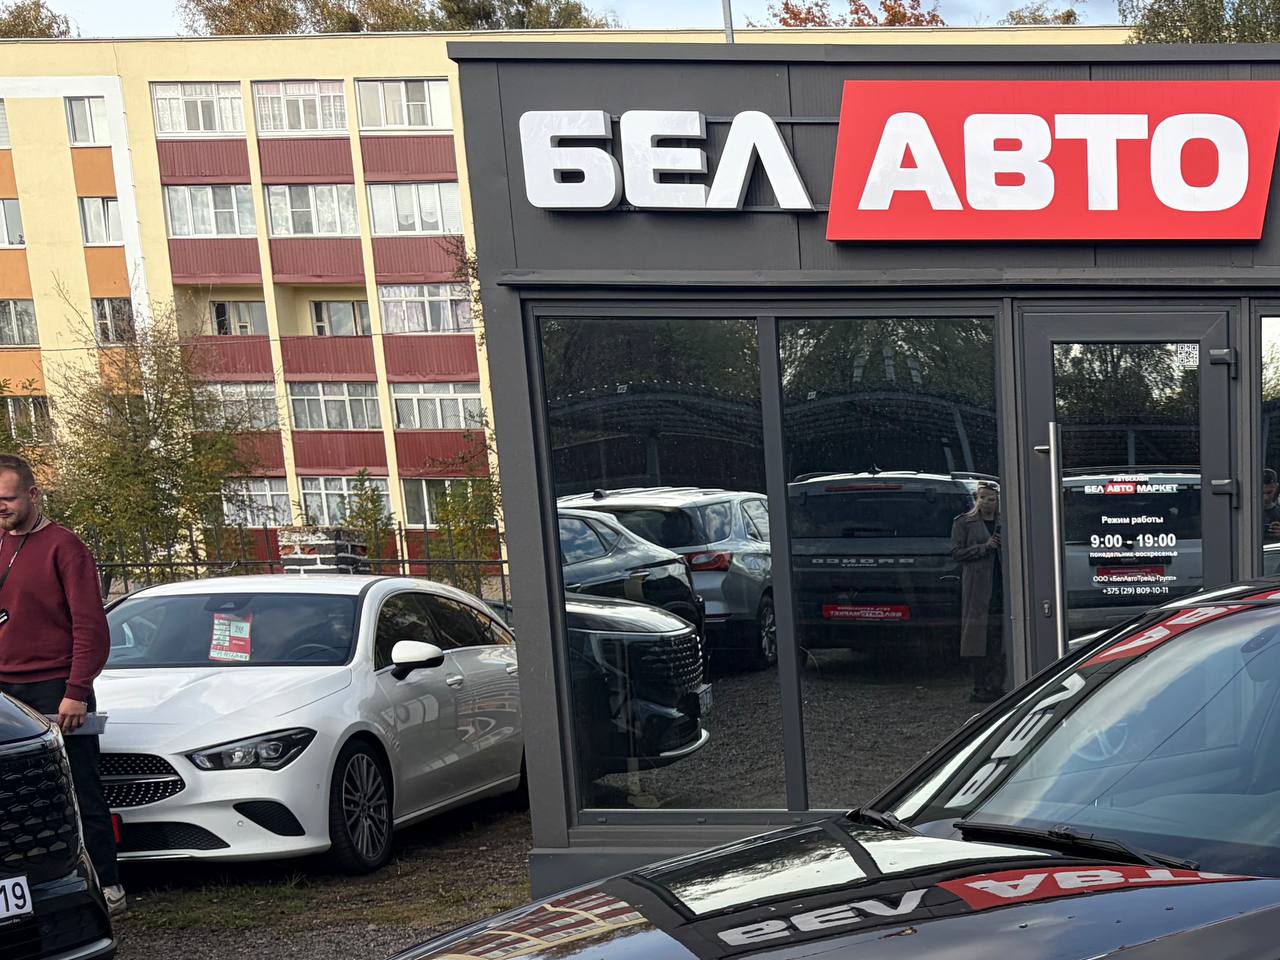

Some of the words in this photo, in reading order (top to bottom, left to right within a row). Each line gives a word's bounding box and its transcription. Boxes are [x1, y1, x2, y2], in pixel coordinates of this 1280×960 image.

[519, 110, 815, 211] БЕЛ
[857, 112, 1249, 212] АВТО
[1084, 485, 1104, 494] БЕЛ
[1136, 484, 1179, 493] МАРКЕТ
[1101, 516, 1130, 524] Режим
[1131, 516, 1164, 525] работы
[1090, 534, 1123, 548] 9:00
[1136, 533, 1176, 547] 19:00
[1102, 587, 1120, 595] +375
[1136, 586, 1169, 594] 809-10-11
